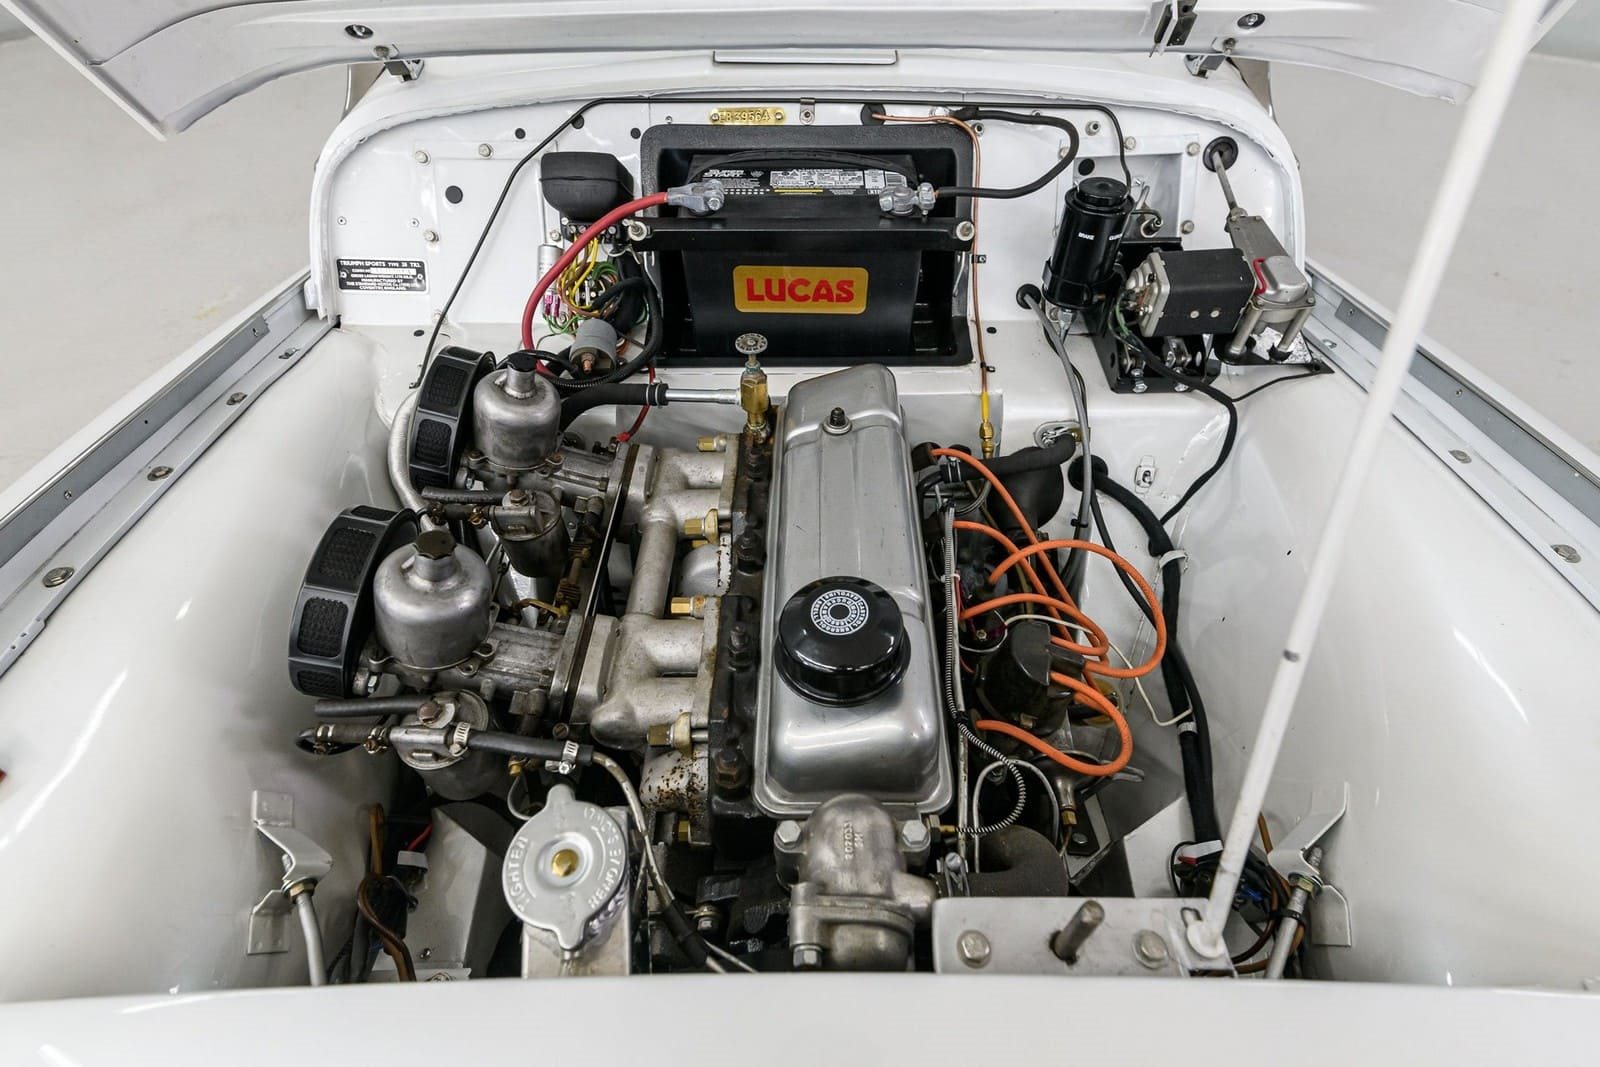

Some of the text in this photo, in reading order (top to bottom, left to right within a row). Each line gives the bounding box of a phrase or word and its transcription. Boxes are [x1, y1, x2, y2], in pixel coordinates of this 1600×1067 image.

[746, 278, 855, 303] LUCAS
[507, 836, 529, 912] TIGHTEN
[588, 848, 622, 909] REMOVE
